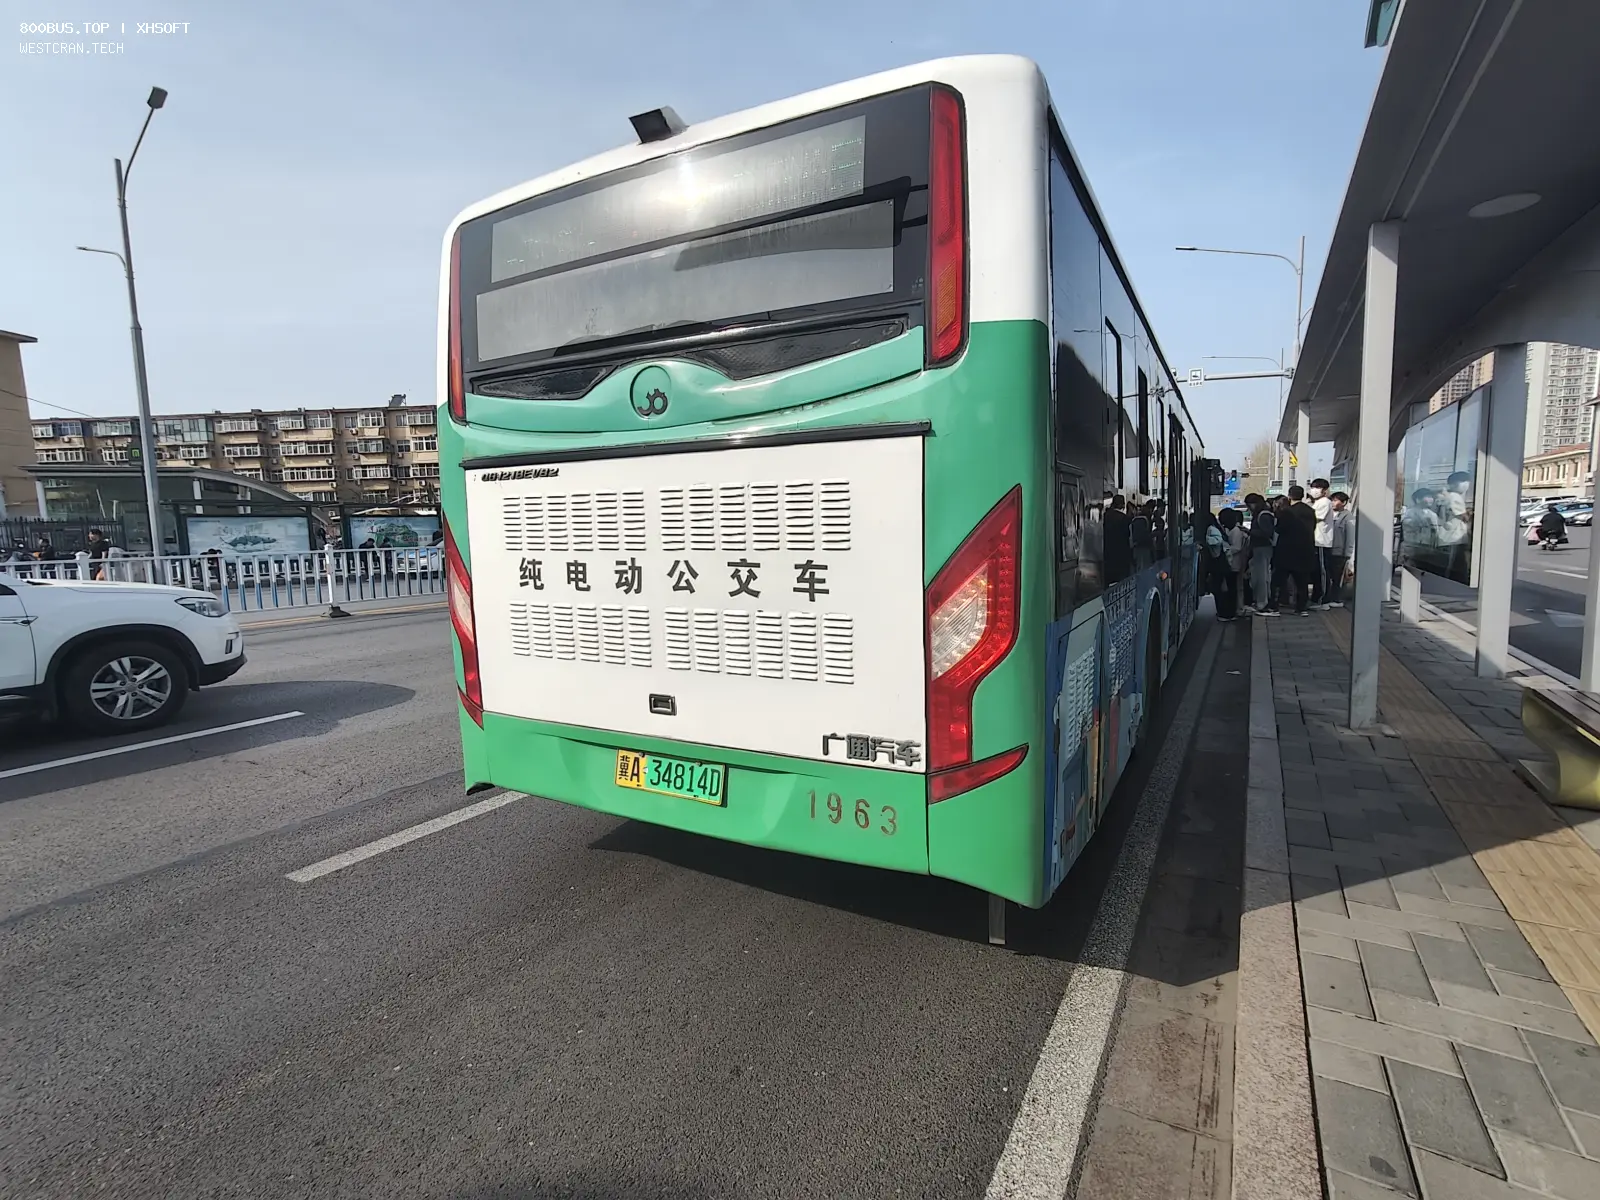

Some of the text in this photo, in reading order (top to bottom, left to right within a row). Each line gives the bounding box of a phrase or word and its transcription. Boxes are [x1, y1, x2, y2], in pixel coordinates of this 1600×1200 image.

[518, 556, 830, 602] 纯电动公交车
[618, 754, 721, 797] 冀A34814D
[807, 788, 898, 836] 1963
